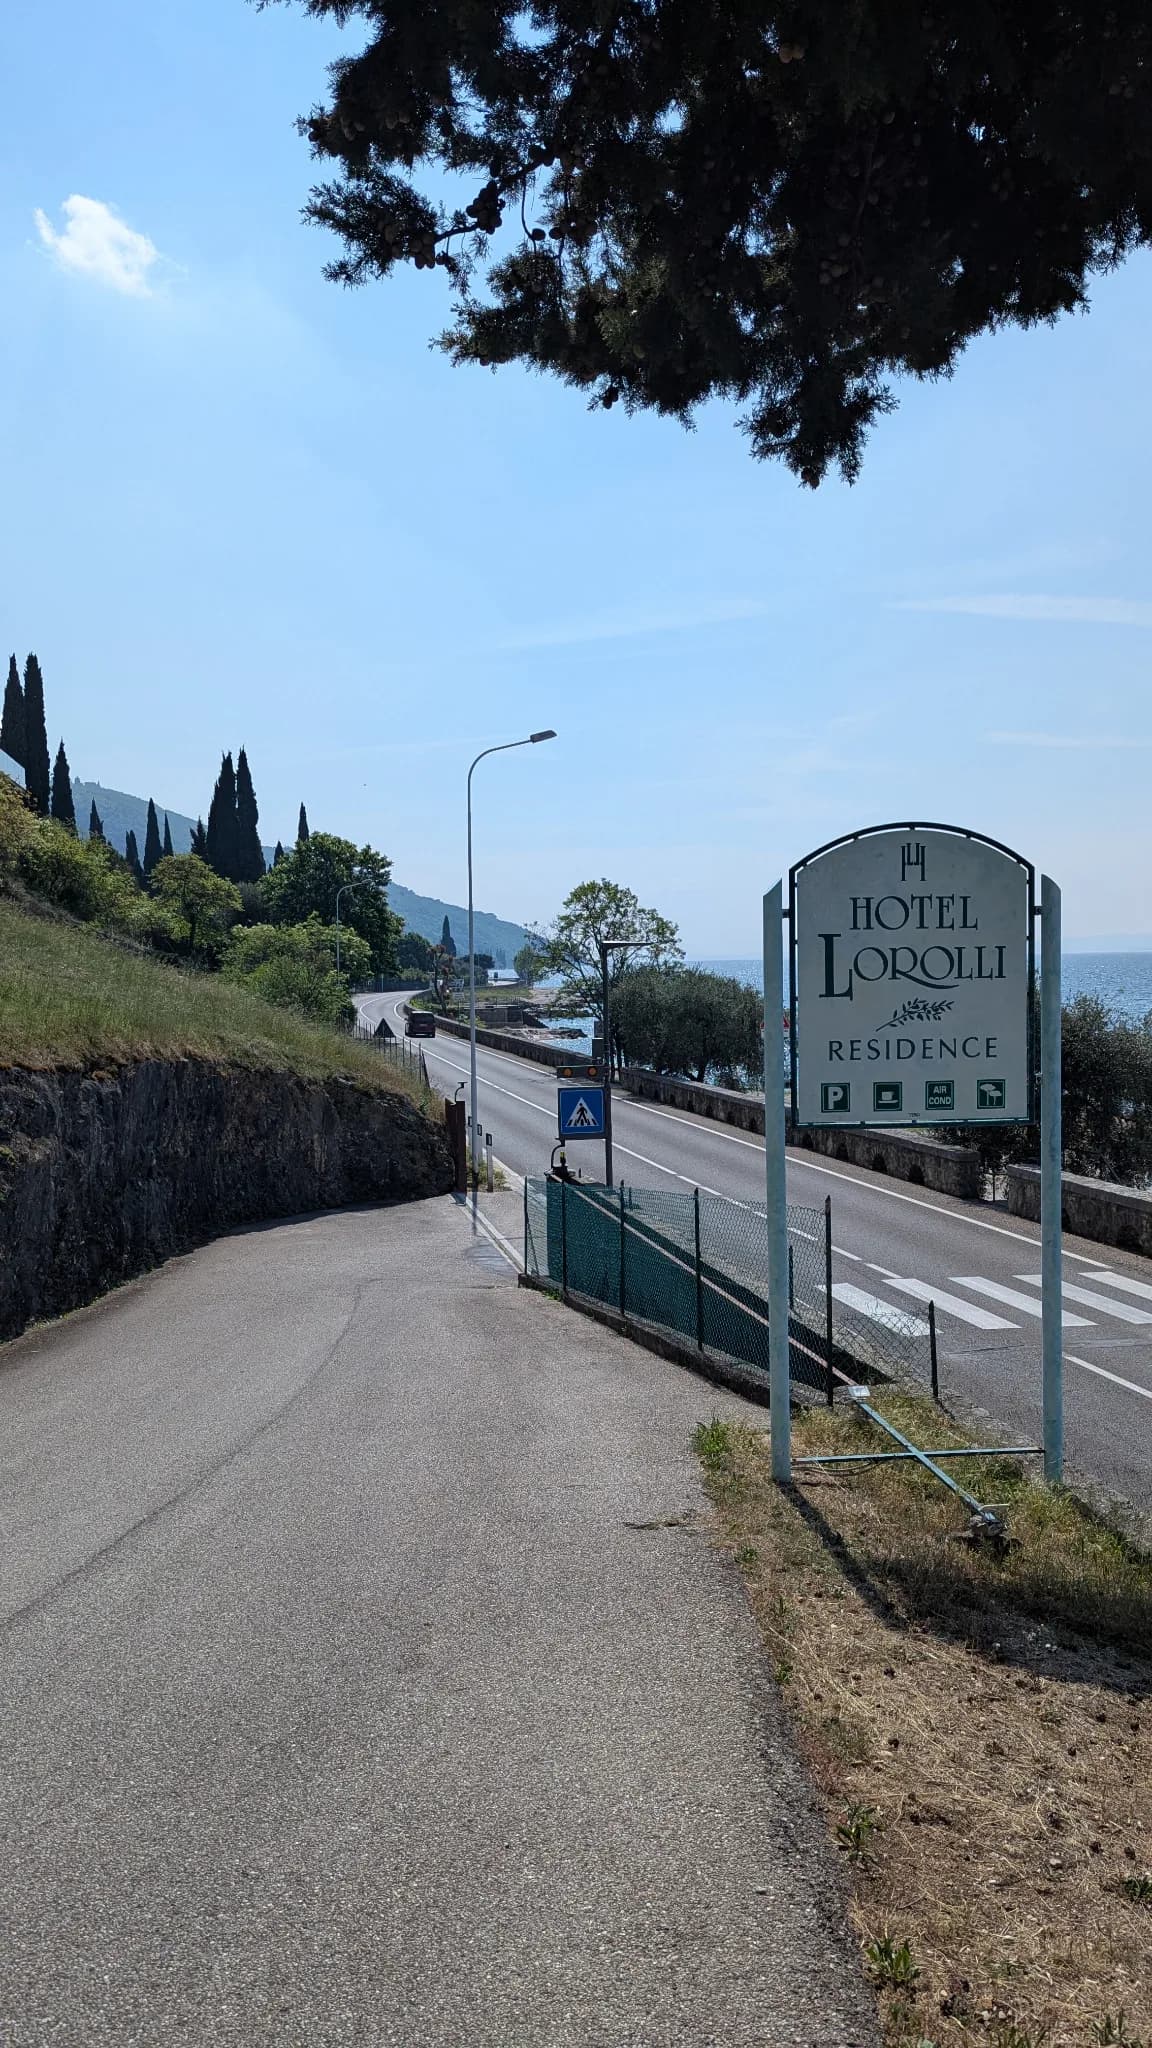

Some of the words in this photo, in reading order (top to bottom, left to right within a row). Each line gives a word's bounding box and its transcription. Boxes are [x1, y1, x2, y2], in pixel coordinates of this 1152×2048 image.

[850, 893, 978, 931] HOTEL
[817, 933, 1007, 1001] LOROLLI
[828, 1036, 998, 1062] RESIDENCE
[828, 1086, 843, 1110] P
[928, 1096, 952, 1105] COND
[933, 1085, 947, 1095] AIR
